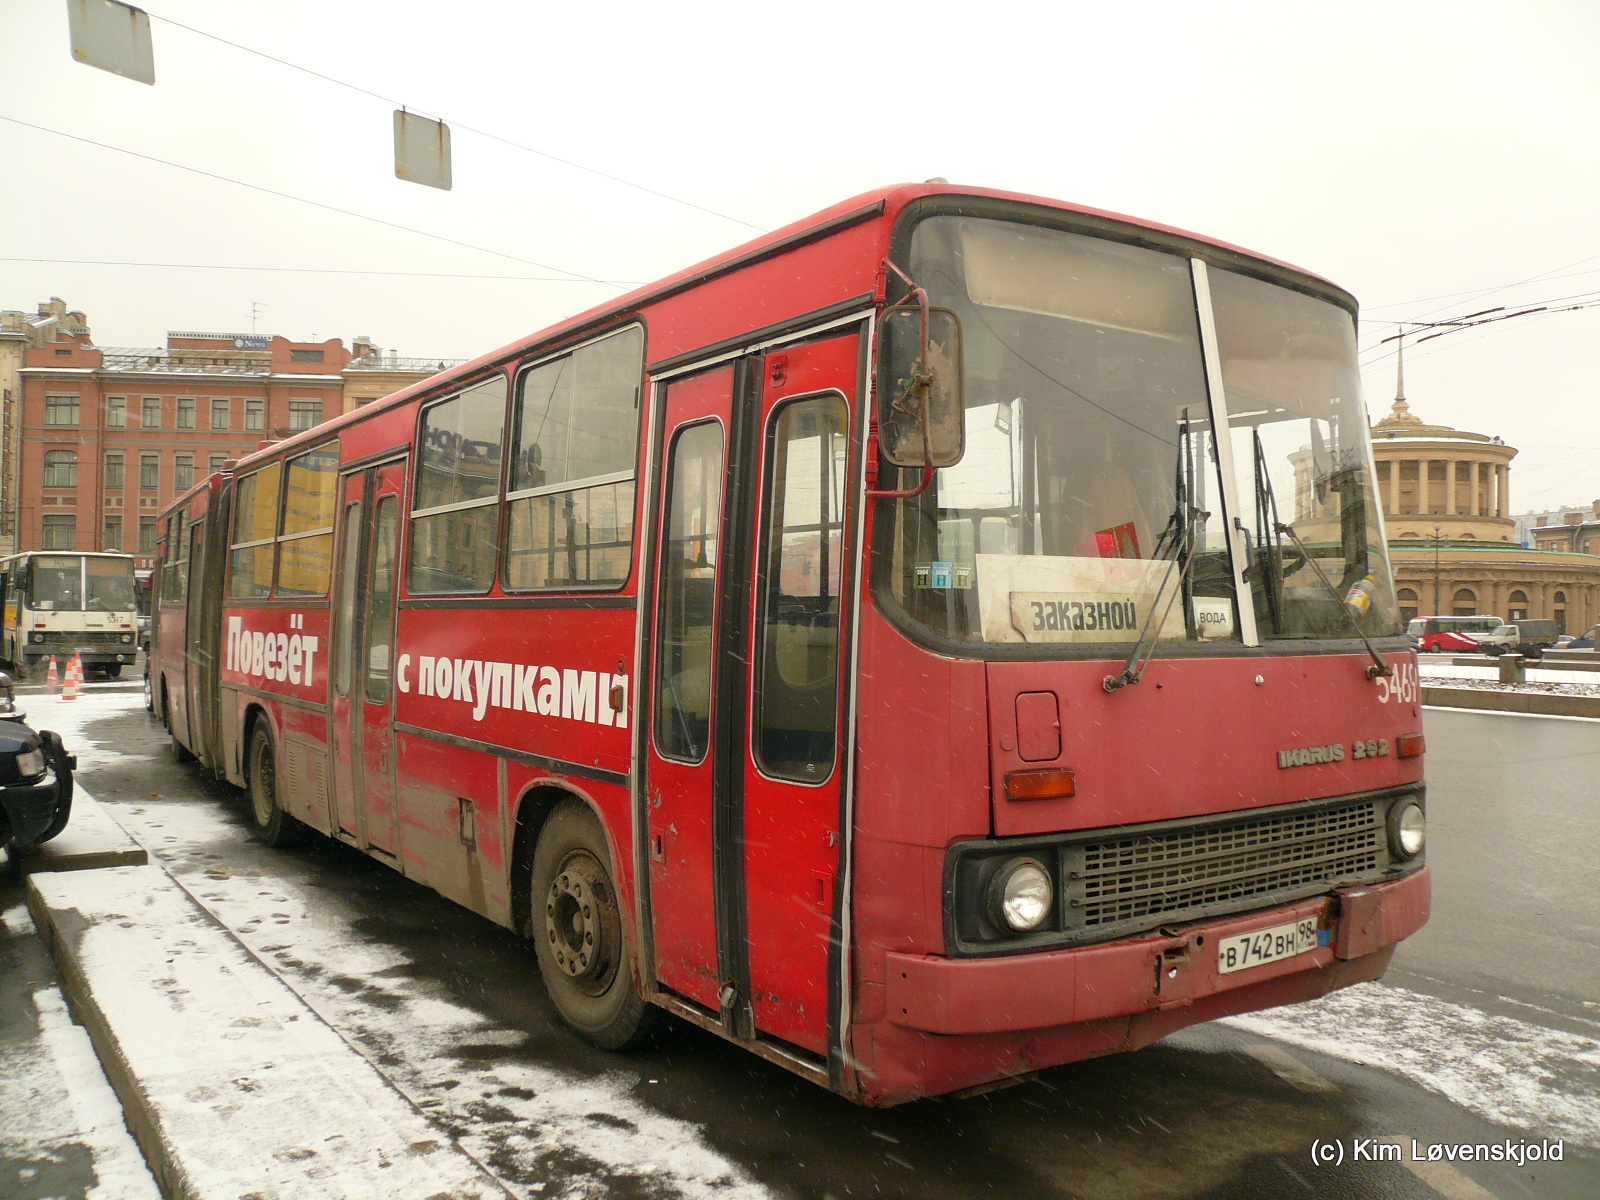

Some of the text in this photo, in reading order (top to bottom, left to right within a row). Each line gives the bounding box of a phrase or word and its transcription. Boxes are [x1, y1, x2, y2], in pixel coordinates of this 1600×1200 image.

[1030, 597, 1138, 632] заказной
[1199, 612, 1227, 625] ВОДА
[226, 613, 319, 687] Повезёт
[397, 653, 630, 729] с покупками
[1278, 743, 1345, 769] IKARUS
